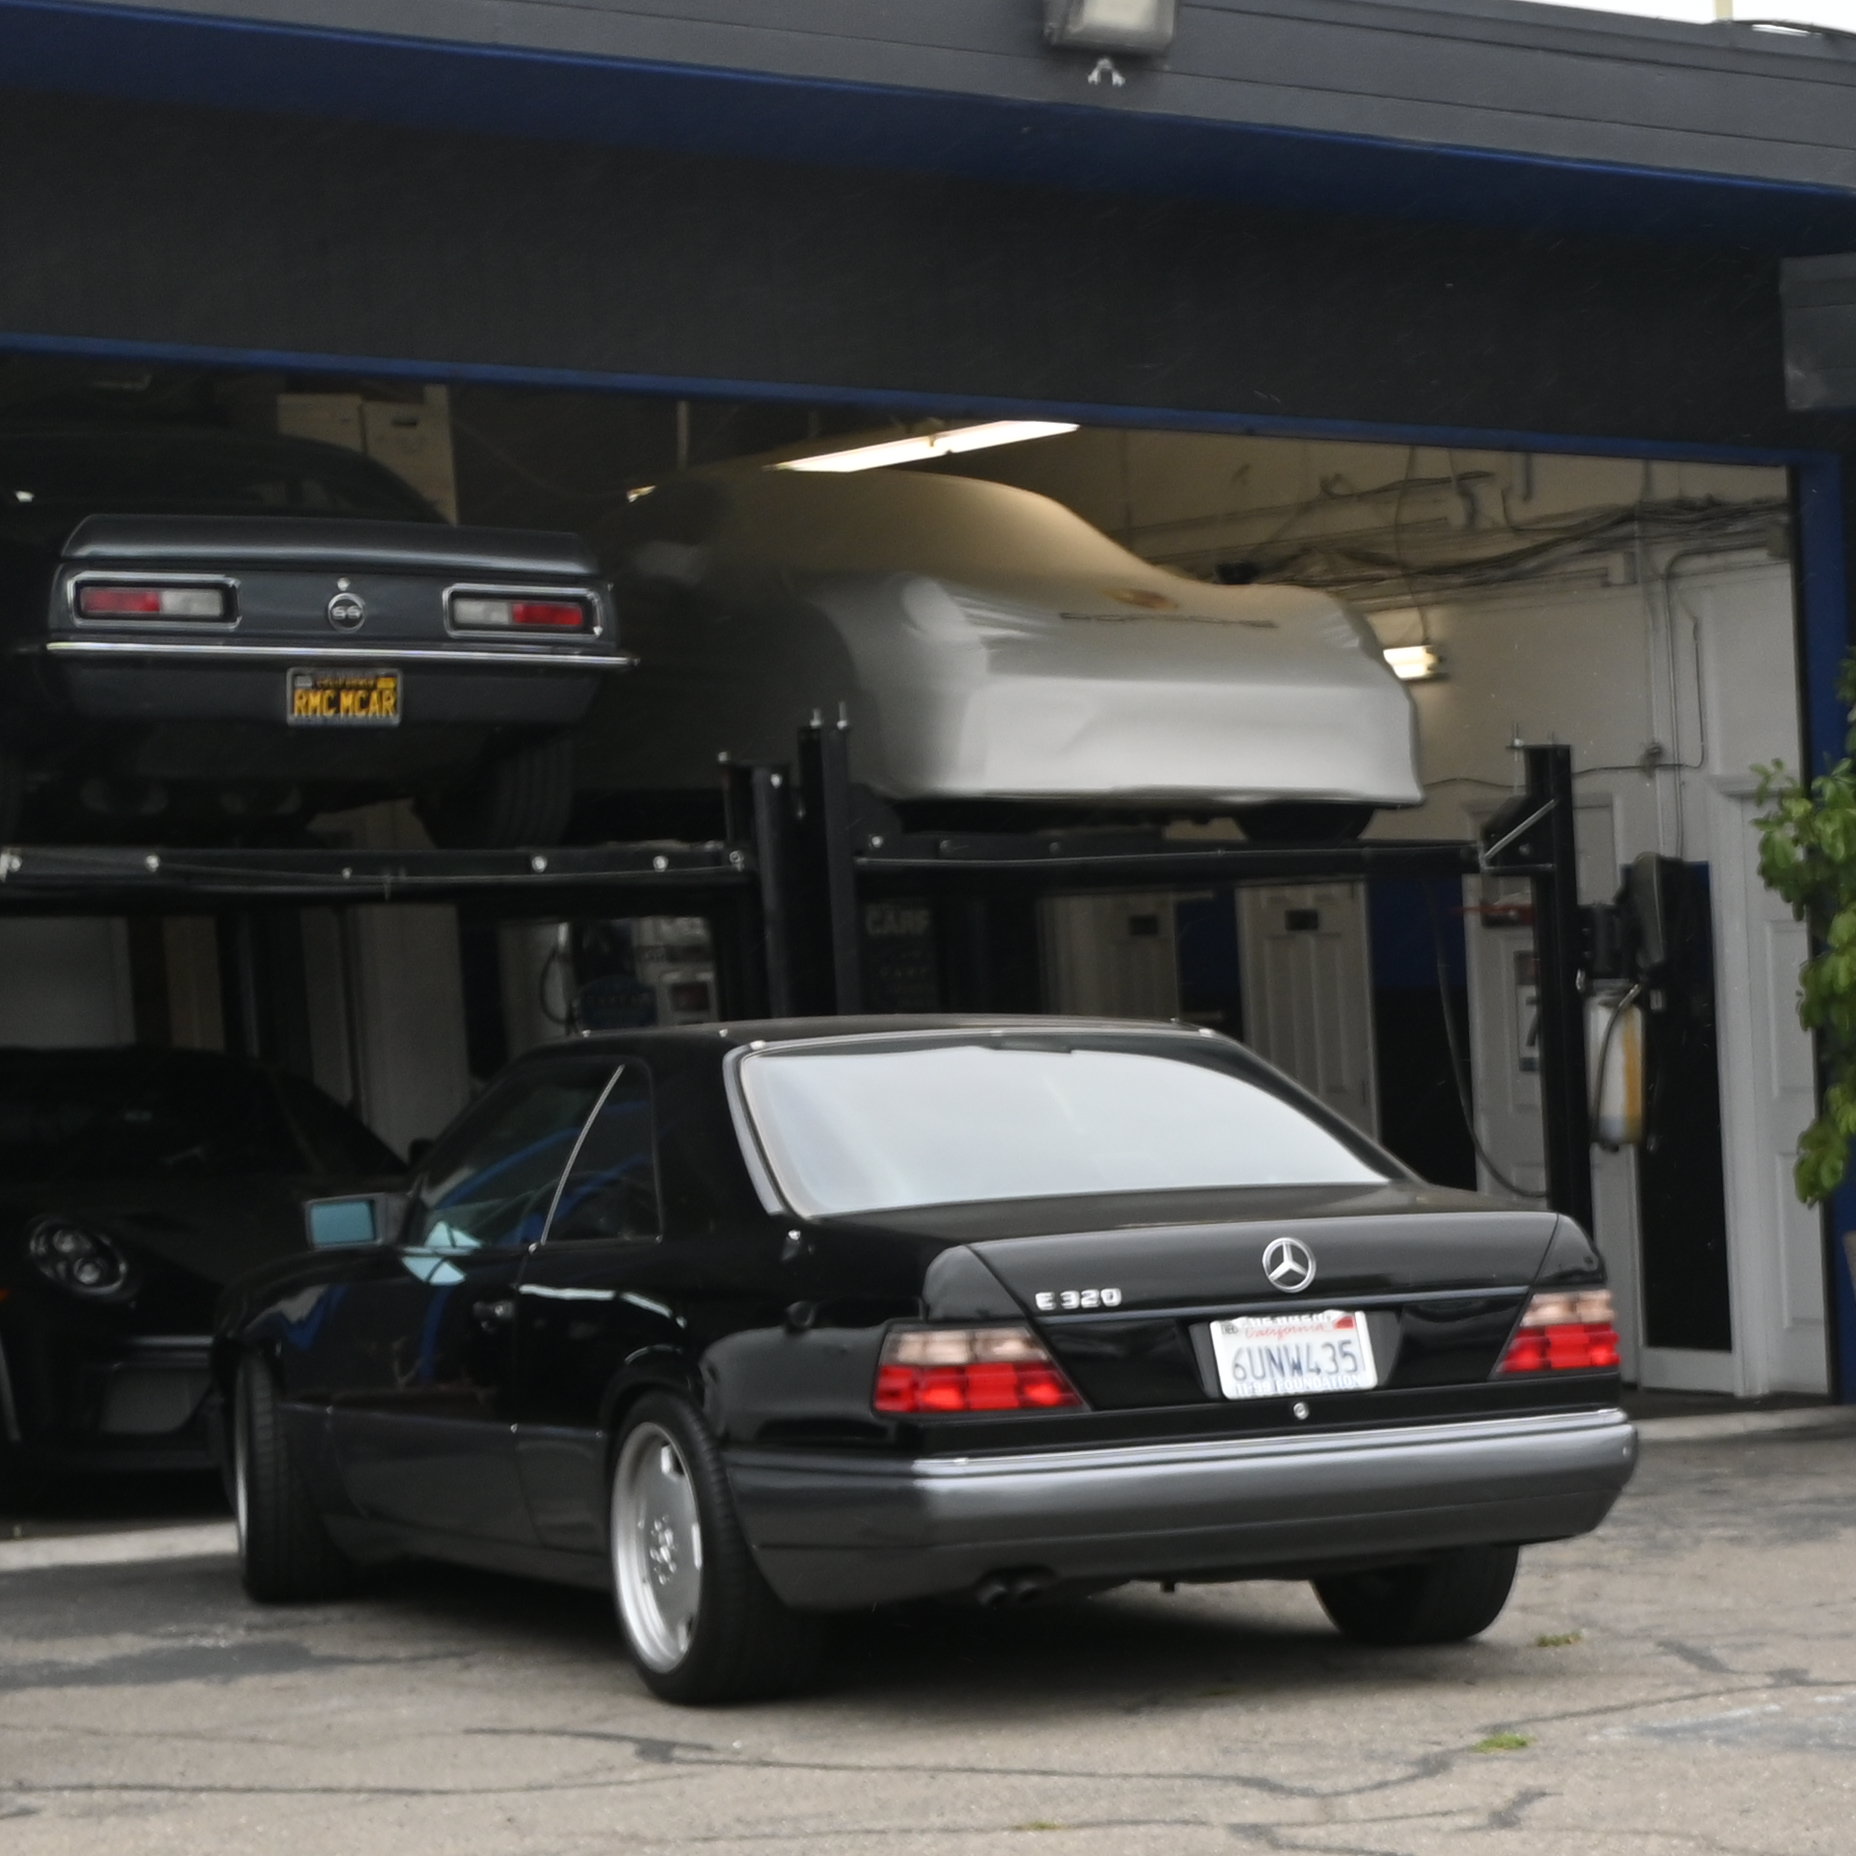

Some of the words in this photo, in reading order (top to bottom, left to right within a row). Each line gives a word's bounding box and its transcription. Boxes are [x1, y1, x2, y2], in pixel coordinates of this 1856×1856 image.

[294, 688, 336, 717] RMC
[339, 688, 396, 718] MCAR
[1035, 1291, 1056, 1311] E
[1060, 1287, 1122, 1309] 320
[1232, 1339, 1359, 1382] 6UNW435
[1276, 1373, 1363, 1393] FOUNDATION
